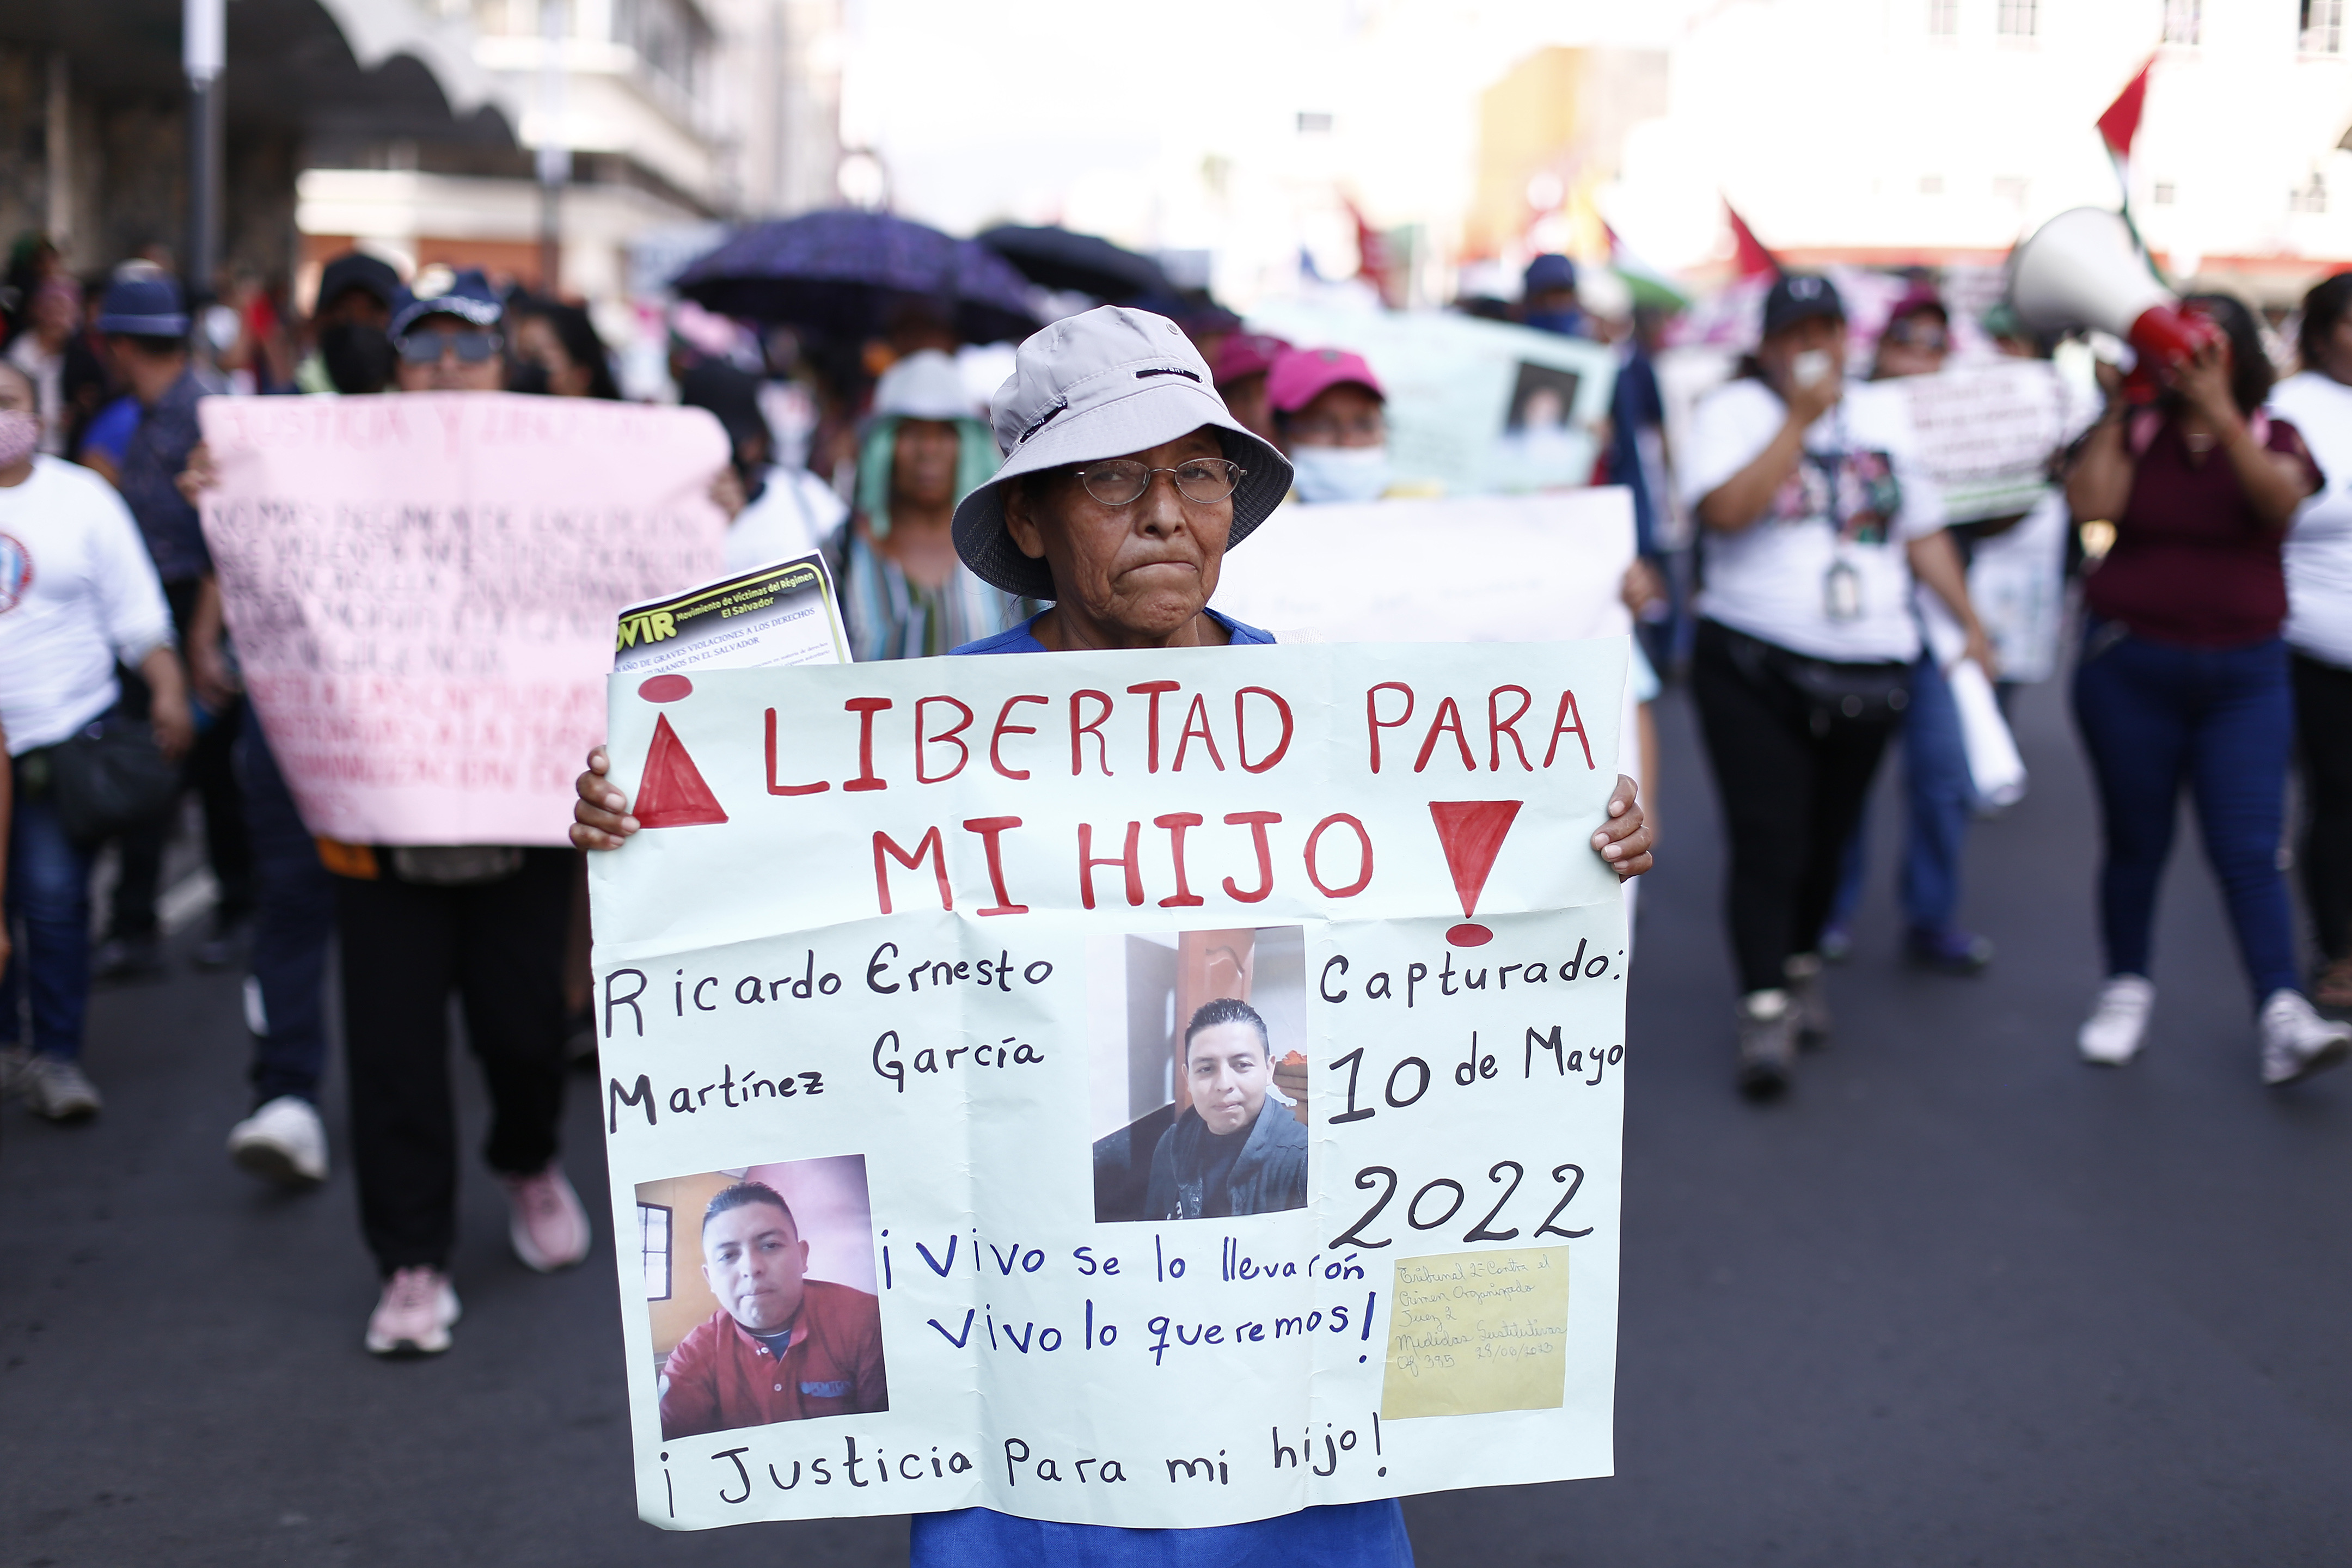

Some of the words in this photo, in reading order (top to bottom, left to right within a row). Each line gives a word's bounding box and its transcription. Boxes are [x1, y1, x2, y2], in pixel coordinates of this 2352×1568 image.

[676, 601, 722, 621] Movimiento
[722, 596, 733, 606] de
[767, 581, 780, 592] del
[780, 572, 814, 589] Régimen
[721, 608, 732, 618] El
[732, 597, 775, 615] Salvador
[640, 658, 652, 667] DE
[654, 647, 686, 664] GRAVES
[688, 629, 745, 652] VIOLACIONES
[754, 622, 770, 633] LOS
[771, 607, 816, 627] DERECHOS
[688, 654, 700, 663] EN
[701, 651, 713, 659] EL
[714, 636, 761, 657] SALVADOR
[1367, 682, 1595, 774] PARA
[873, 817, 1030, 916] MI
[606, 950, 841, 1038] Ricardo
[867, 942, 1053, 994] Ernesto
[1320, 938, 1624, 1008] Capturado:
[610, 1064, 824, 1134] Martínez
[873, 1031, 1044, 1093] García
[1328, 1048, 1430, 1124] 10
[1455, 1031, 1498, 1086] de
[1526, 1025, 1624, 1086] Mayo
[1328, 1161, 1594, 1250] 2022
[1073, 1247, 1120, 1276] se
[1156, 1234, 1185, 1283] lo
[1397, 1263, 1466, 1284] Tribunal
[1538, 1254, 1550, 1269] el
[1086, 1299, 1117, 1350] lo
[1148, 1291, 1376, 1367] queremos!
[1399, 1291, 1451, 1306] Crimen
[1445, 1306, 1457, 1320] 2
[1166, 1449, 1228, 1485] mi
[1273, 1412, 1387, 1477] hijo!
